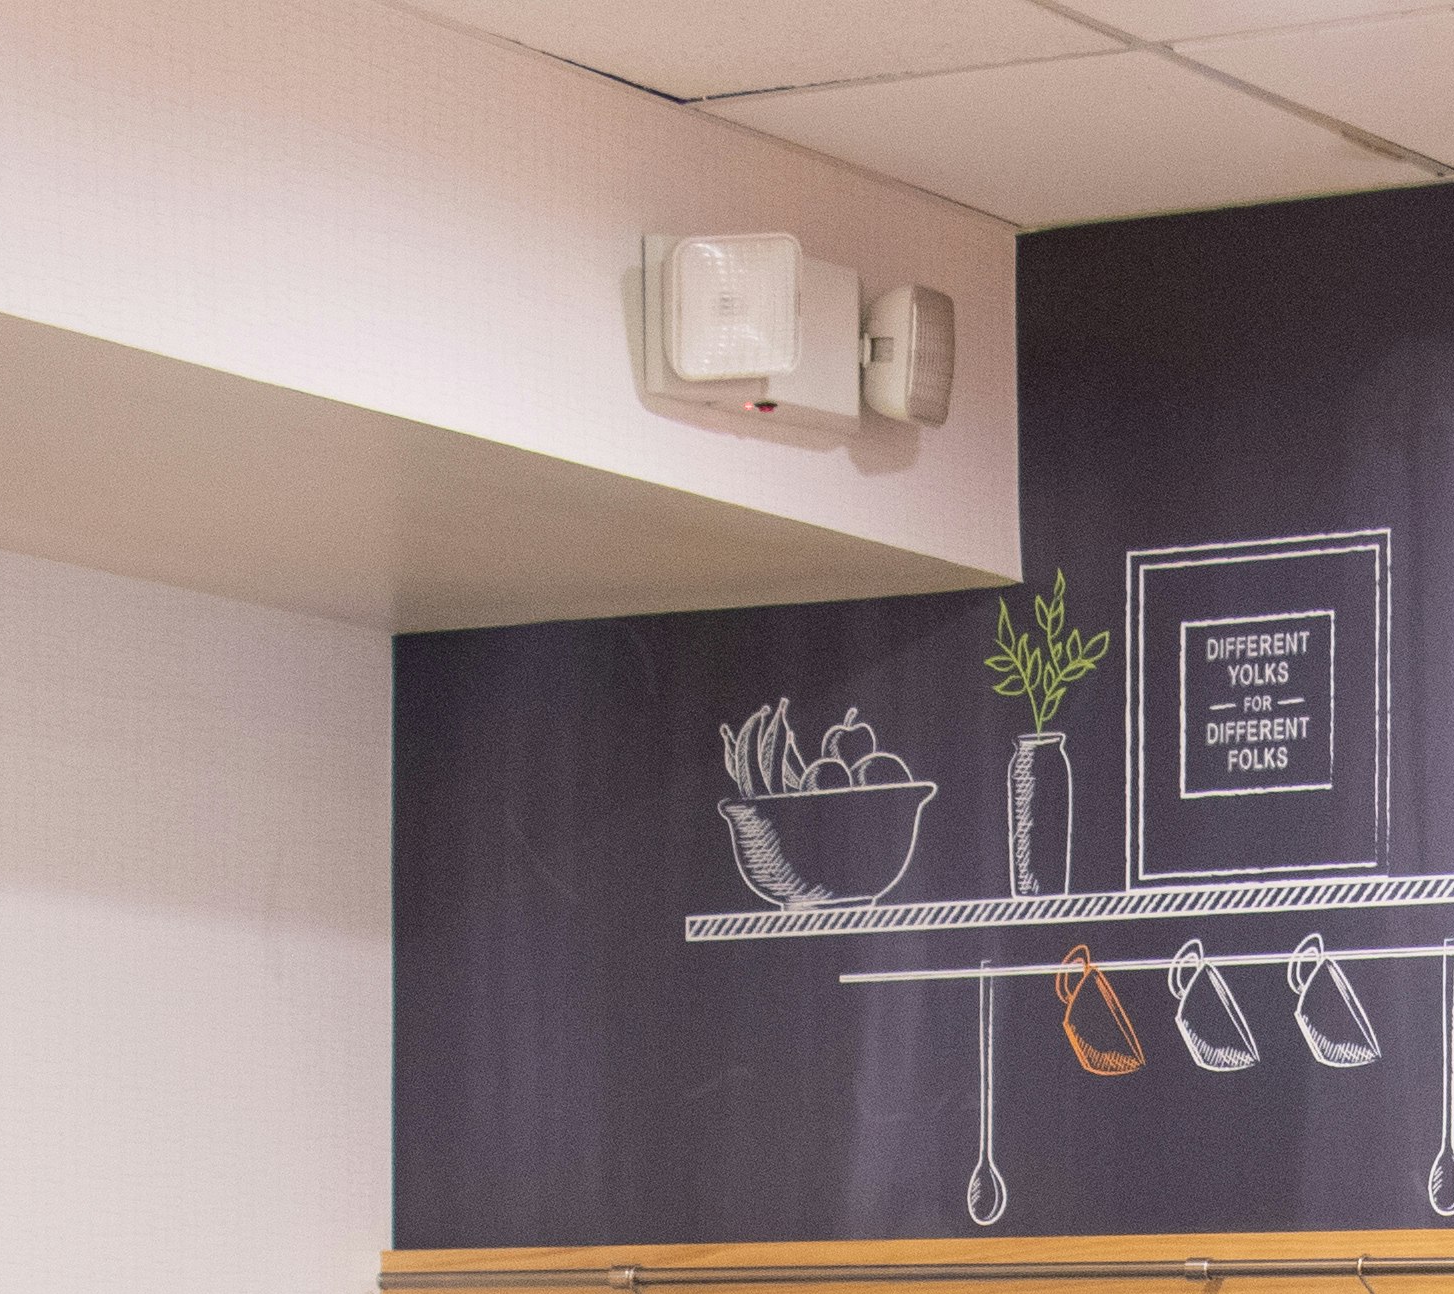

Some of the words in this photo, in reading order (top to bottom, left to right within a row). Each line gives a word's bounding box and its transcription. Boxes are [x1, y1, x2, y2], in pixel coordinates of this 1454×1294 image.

[1206, 631, 1310, 661] DIFFERENT
[1227, 661, 1289, 687] YOLKS
[1243, 695, 1272, 712] FOR
[1206, 717, 1310, 745] DIFFERENT
[1227, 746, 1289, 772] FOLKS
